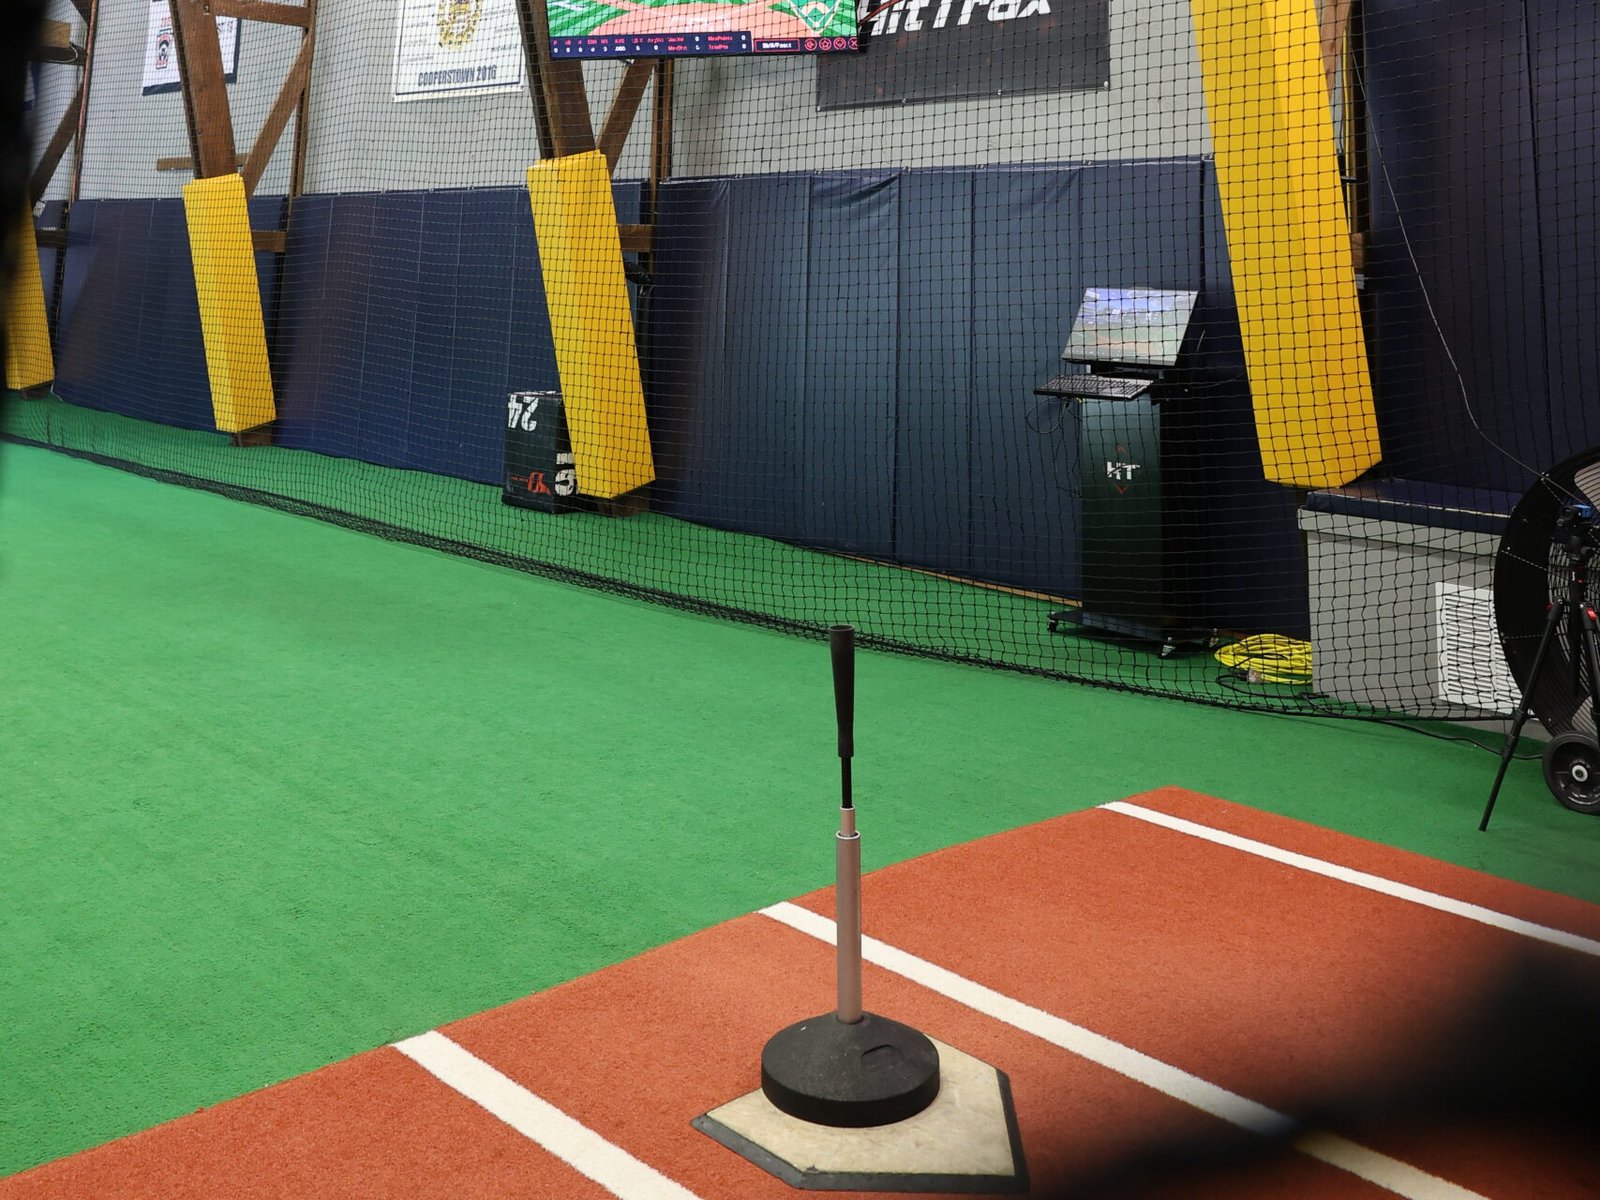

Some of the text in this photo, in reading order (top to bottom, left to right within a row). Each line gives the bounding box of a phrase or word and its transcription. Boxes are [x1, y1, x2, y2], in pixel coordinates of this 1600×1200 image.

[417, 64, 498, 87] COOPERSTOWN 2016
[508, 394, 539, 431] 24
